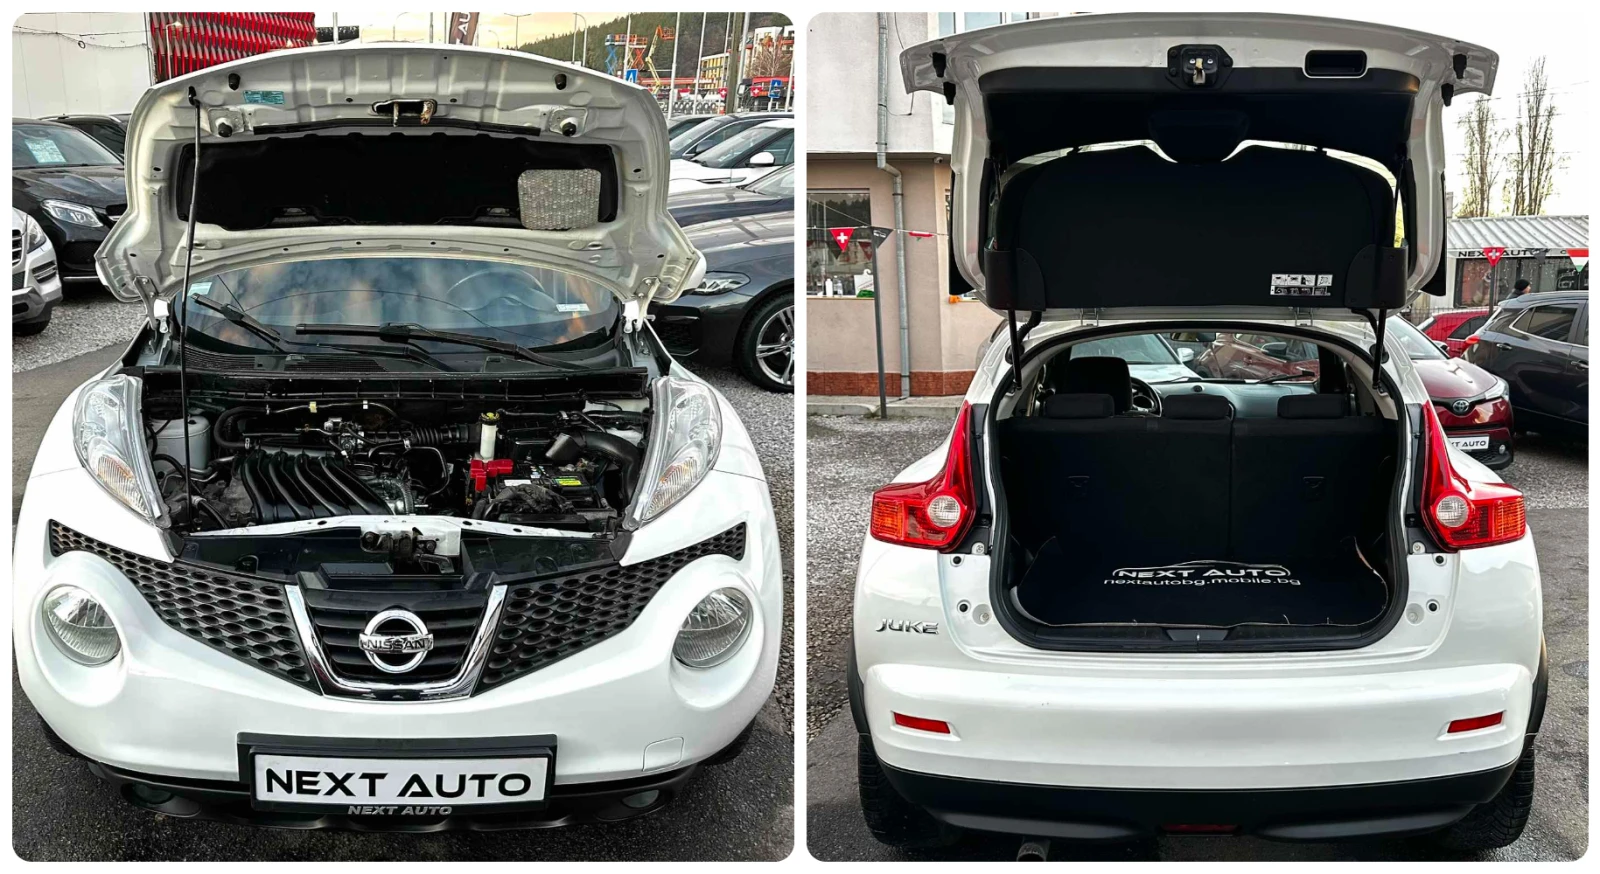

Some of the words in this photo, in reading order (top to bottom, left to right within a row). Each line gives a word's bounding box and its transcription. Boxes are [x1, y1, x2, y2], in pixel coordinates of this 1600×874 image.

[1462, 440, 1487, 448] AUTO
[1118, 569, 1195, 578] NEXT
[1202, 568, 1287, 577] AUTO
[1103, 577, 1302, 587] nextautobg.mobile.bg
[875, 617, 939, 635] JUKE
[366, 637, 426, 650] NISSAN
[265, 768, 389, 797] NEXT
[396, 772, 532, 799] AUTO
[347, 805, 399, 816] NEXT
[400, 805, 453, 816] AUTO
